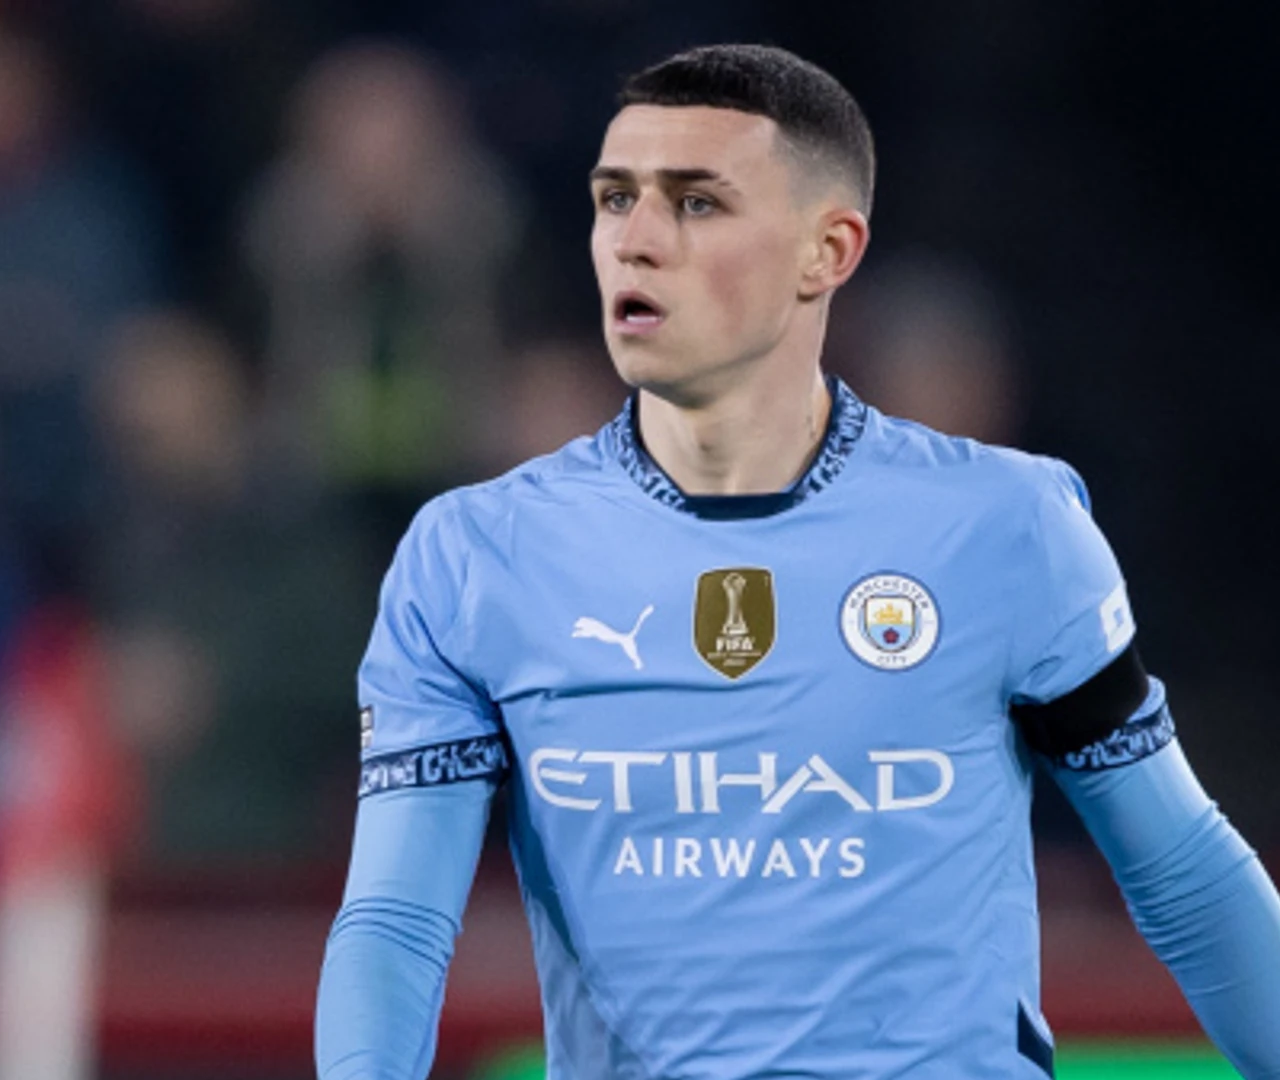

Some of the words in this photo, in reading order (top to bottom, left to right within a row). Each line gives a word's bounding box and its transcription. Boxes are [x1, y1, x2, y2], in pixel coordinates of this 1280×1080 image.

[849, 580, 930, 610] MANCHESTER
[715, 636, 754, 651] FIFA
[528, 747, 955, 814] ETIHAD
[613, 837, 866, 879] AIRWAYS
